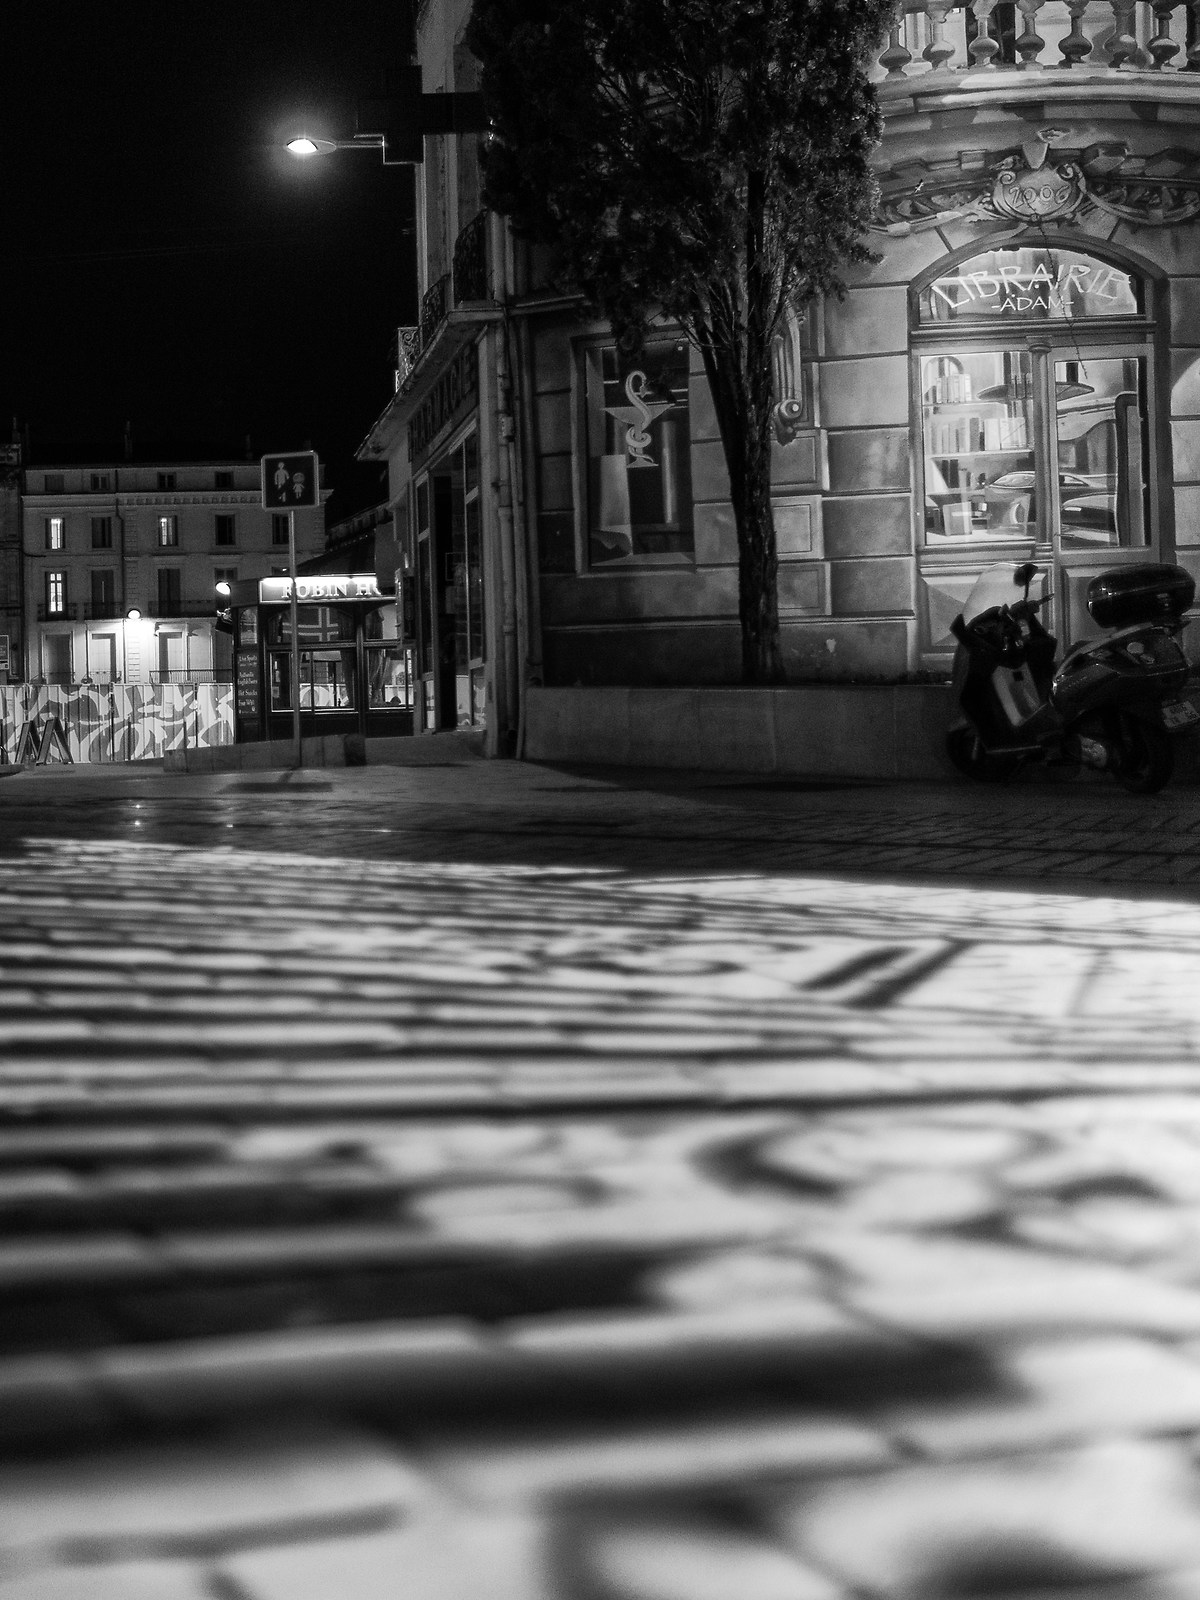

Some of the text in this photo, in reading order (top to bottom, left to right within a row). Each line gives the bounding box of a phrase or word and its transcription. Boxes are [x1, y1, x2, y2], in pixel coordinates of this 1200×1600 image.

[1009, 184, 1070, 208] 2006
[931, 262, 1131, 308] LIBRAIRIE
[281, 584, 348, 598] ROBIN
